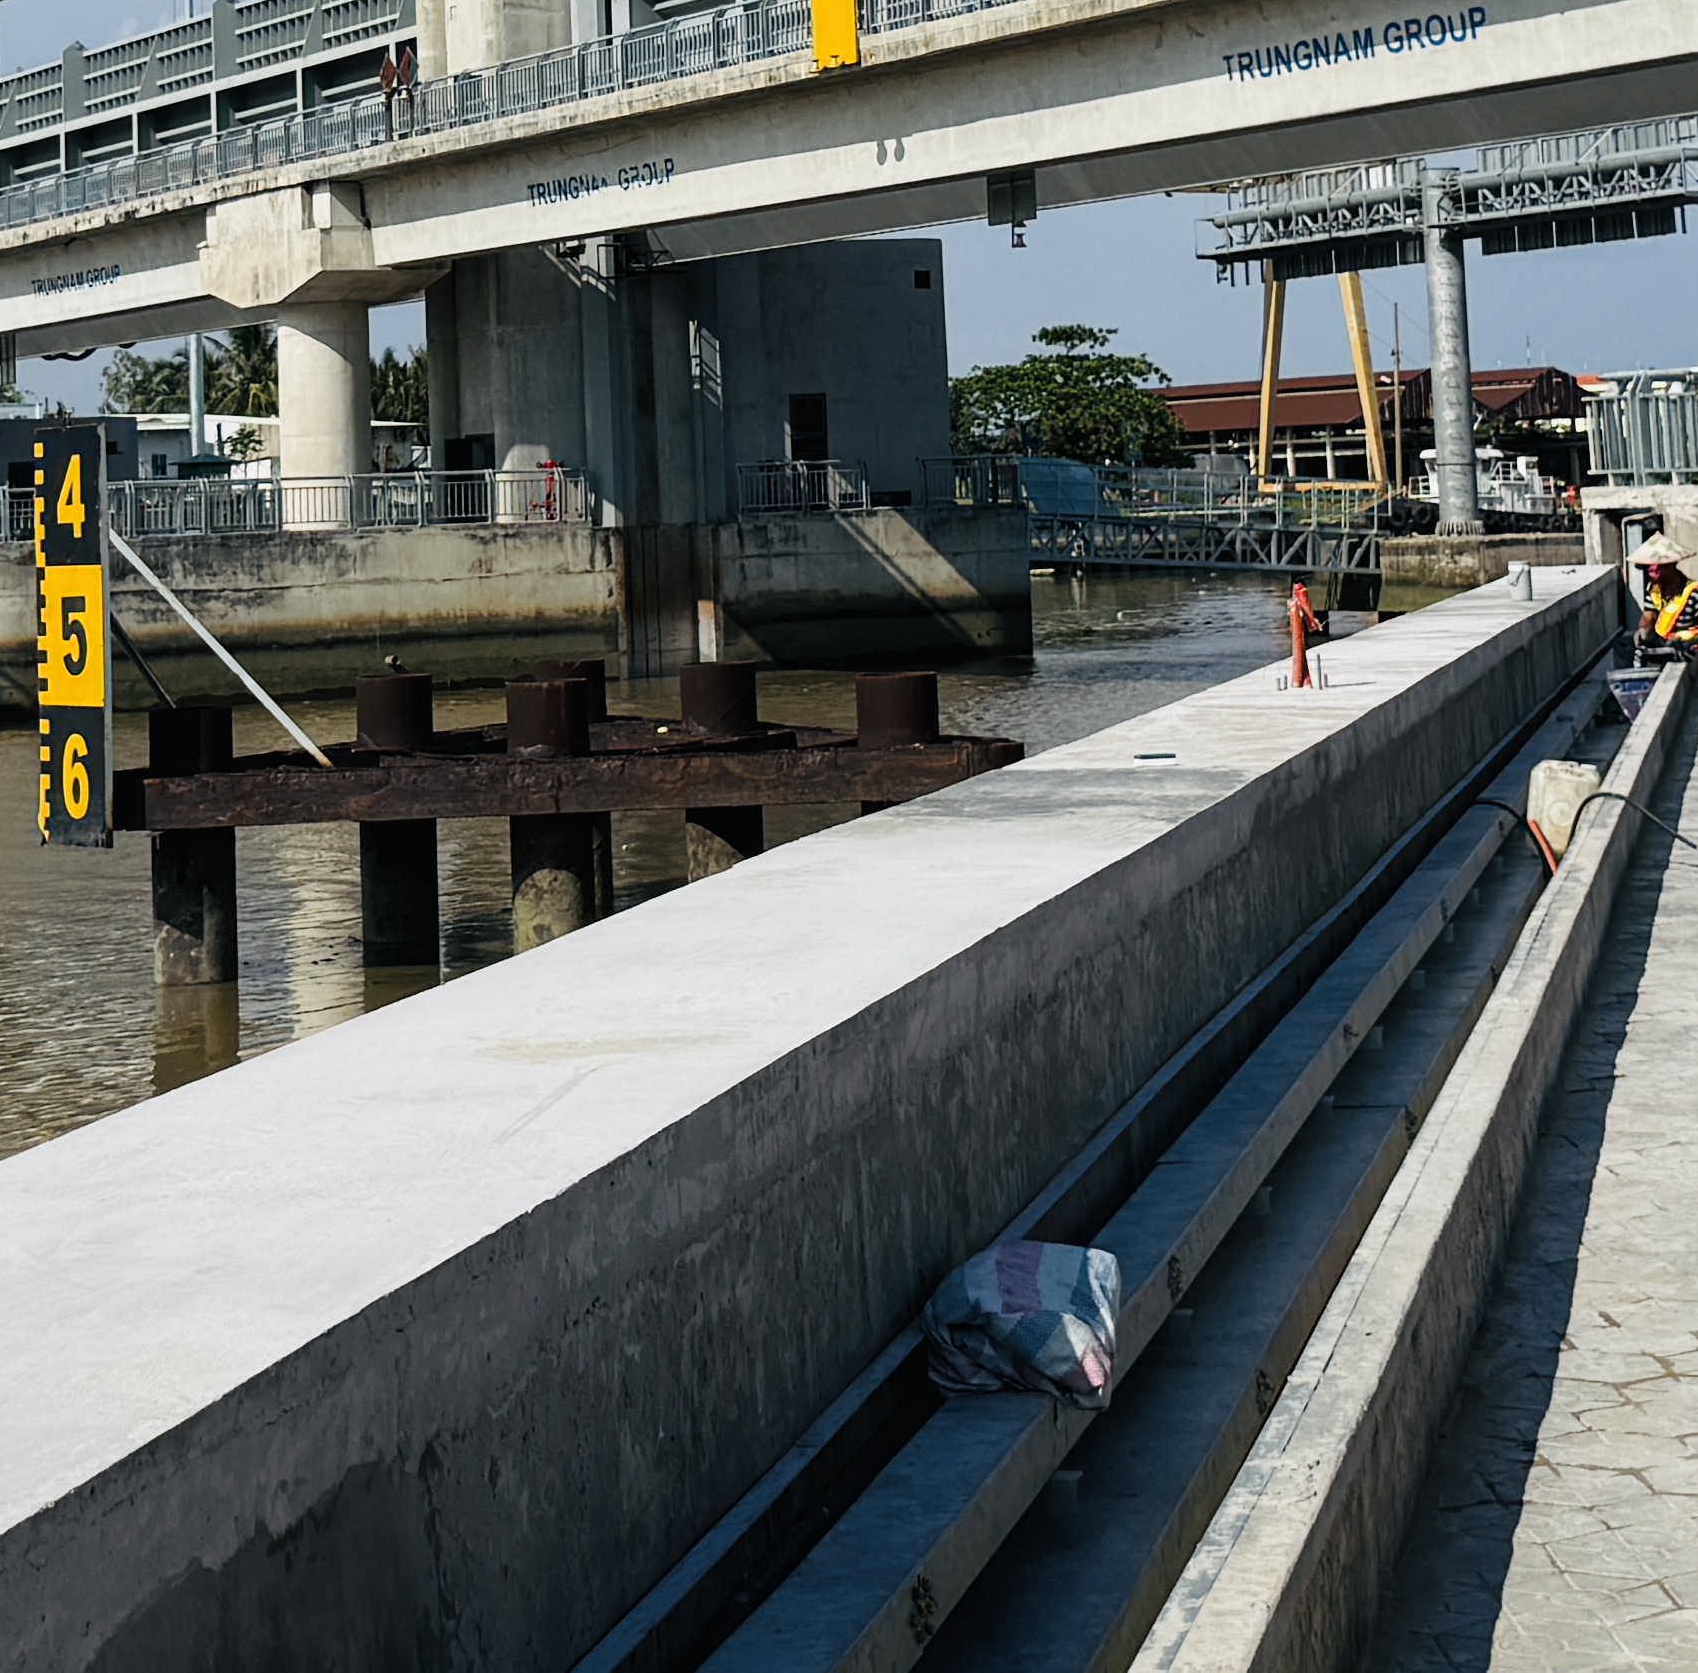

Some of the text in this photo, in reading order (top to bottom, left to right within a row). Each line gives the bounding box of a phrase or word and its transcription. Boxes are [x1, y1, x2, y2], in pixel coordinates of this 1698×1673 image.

[1223, 7, 1486, 81] TRUNGNAM GROUP
[618, 158, 674, 190] GROUP
[86, 265, 121, 287] GROUP
[57, 454, 85, 538] 4
[61, 596, 86, 676] 5
[63, 733, 90, 819] 6
